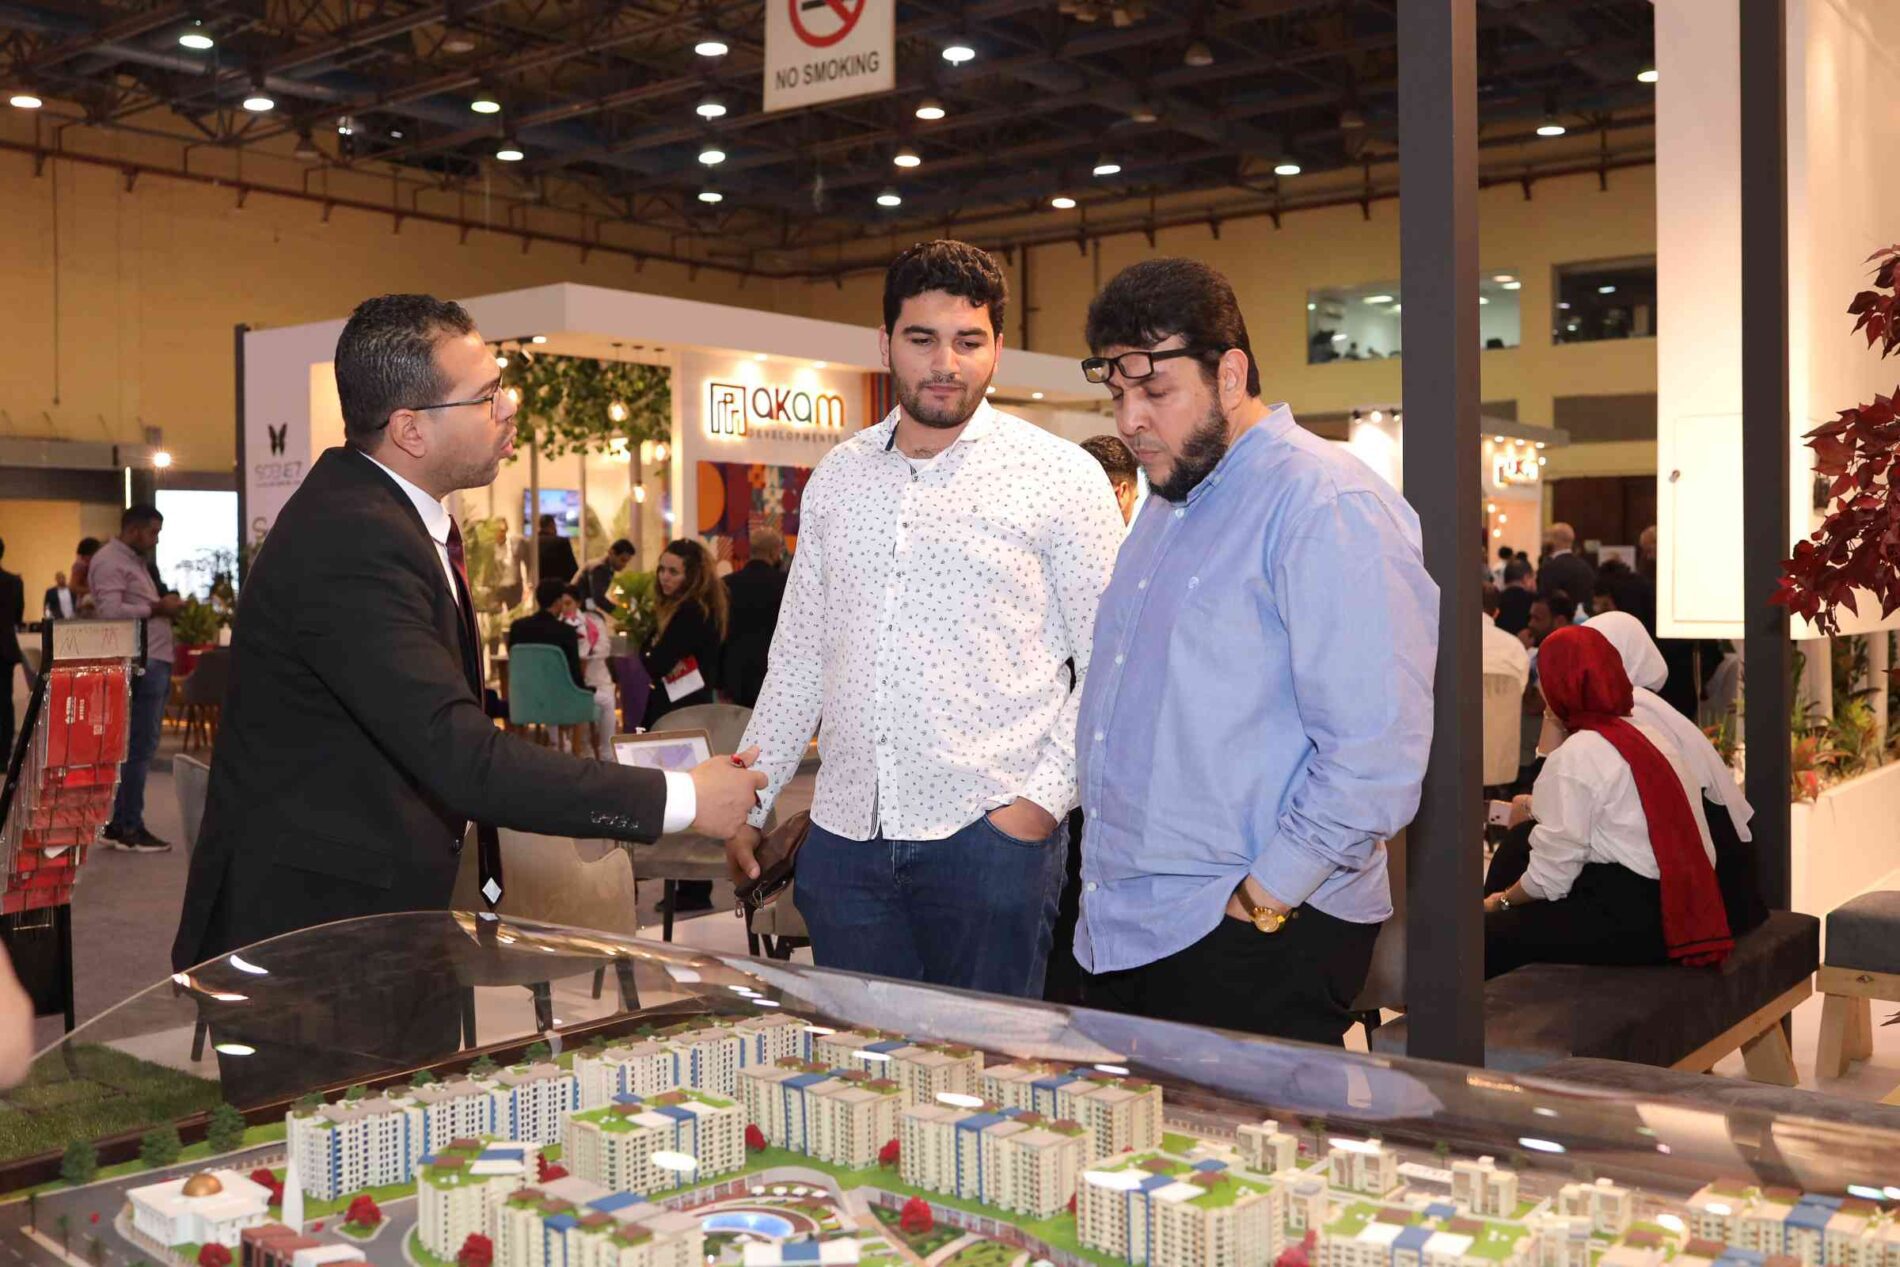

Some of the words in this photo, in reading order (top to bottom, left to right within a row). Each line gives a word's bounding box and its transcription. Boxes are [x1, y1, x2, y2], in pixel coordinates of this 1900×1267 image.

[775, 67, 799, 89] NO
[803, 51, 880, 85] SMOKING
[752, 387, 844, 427] akam
